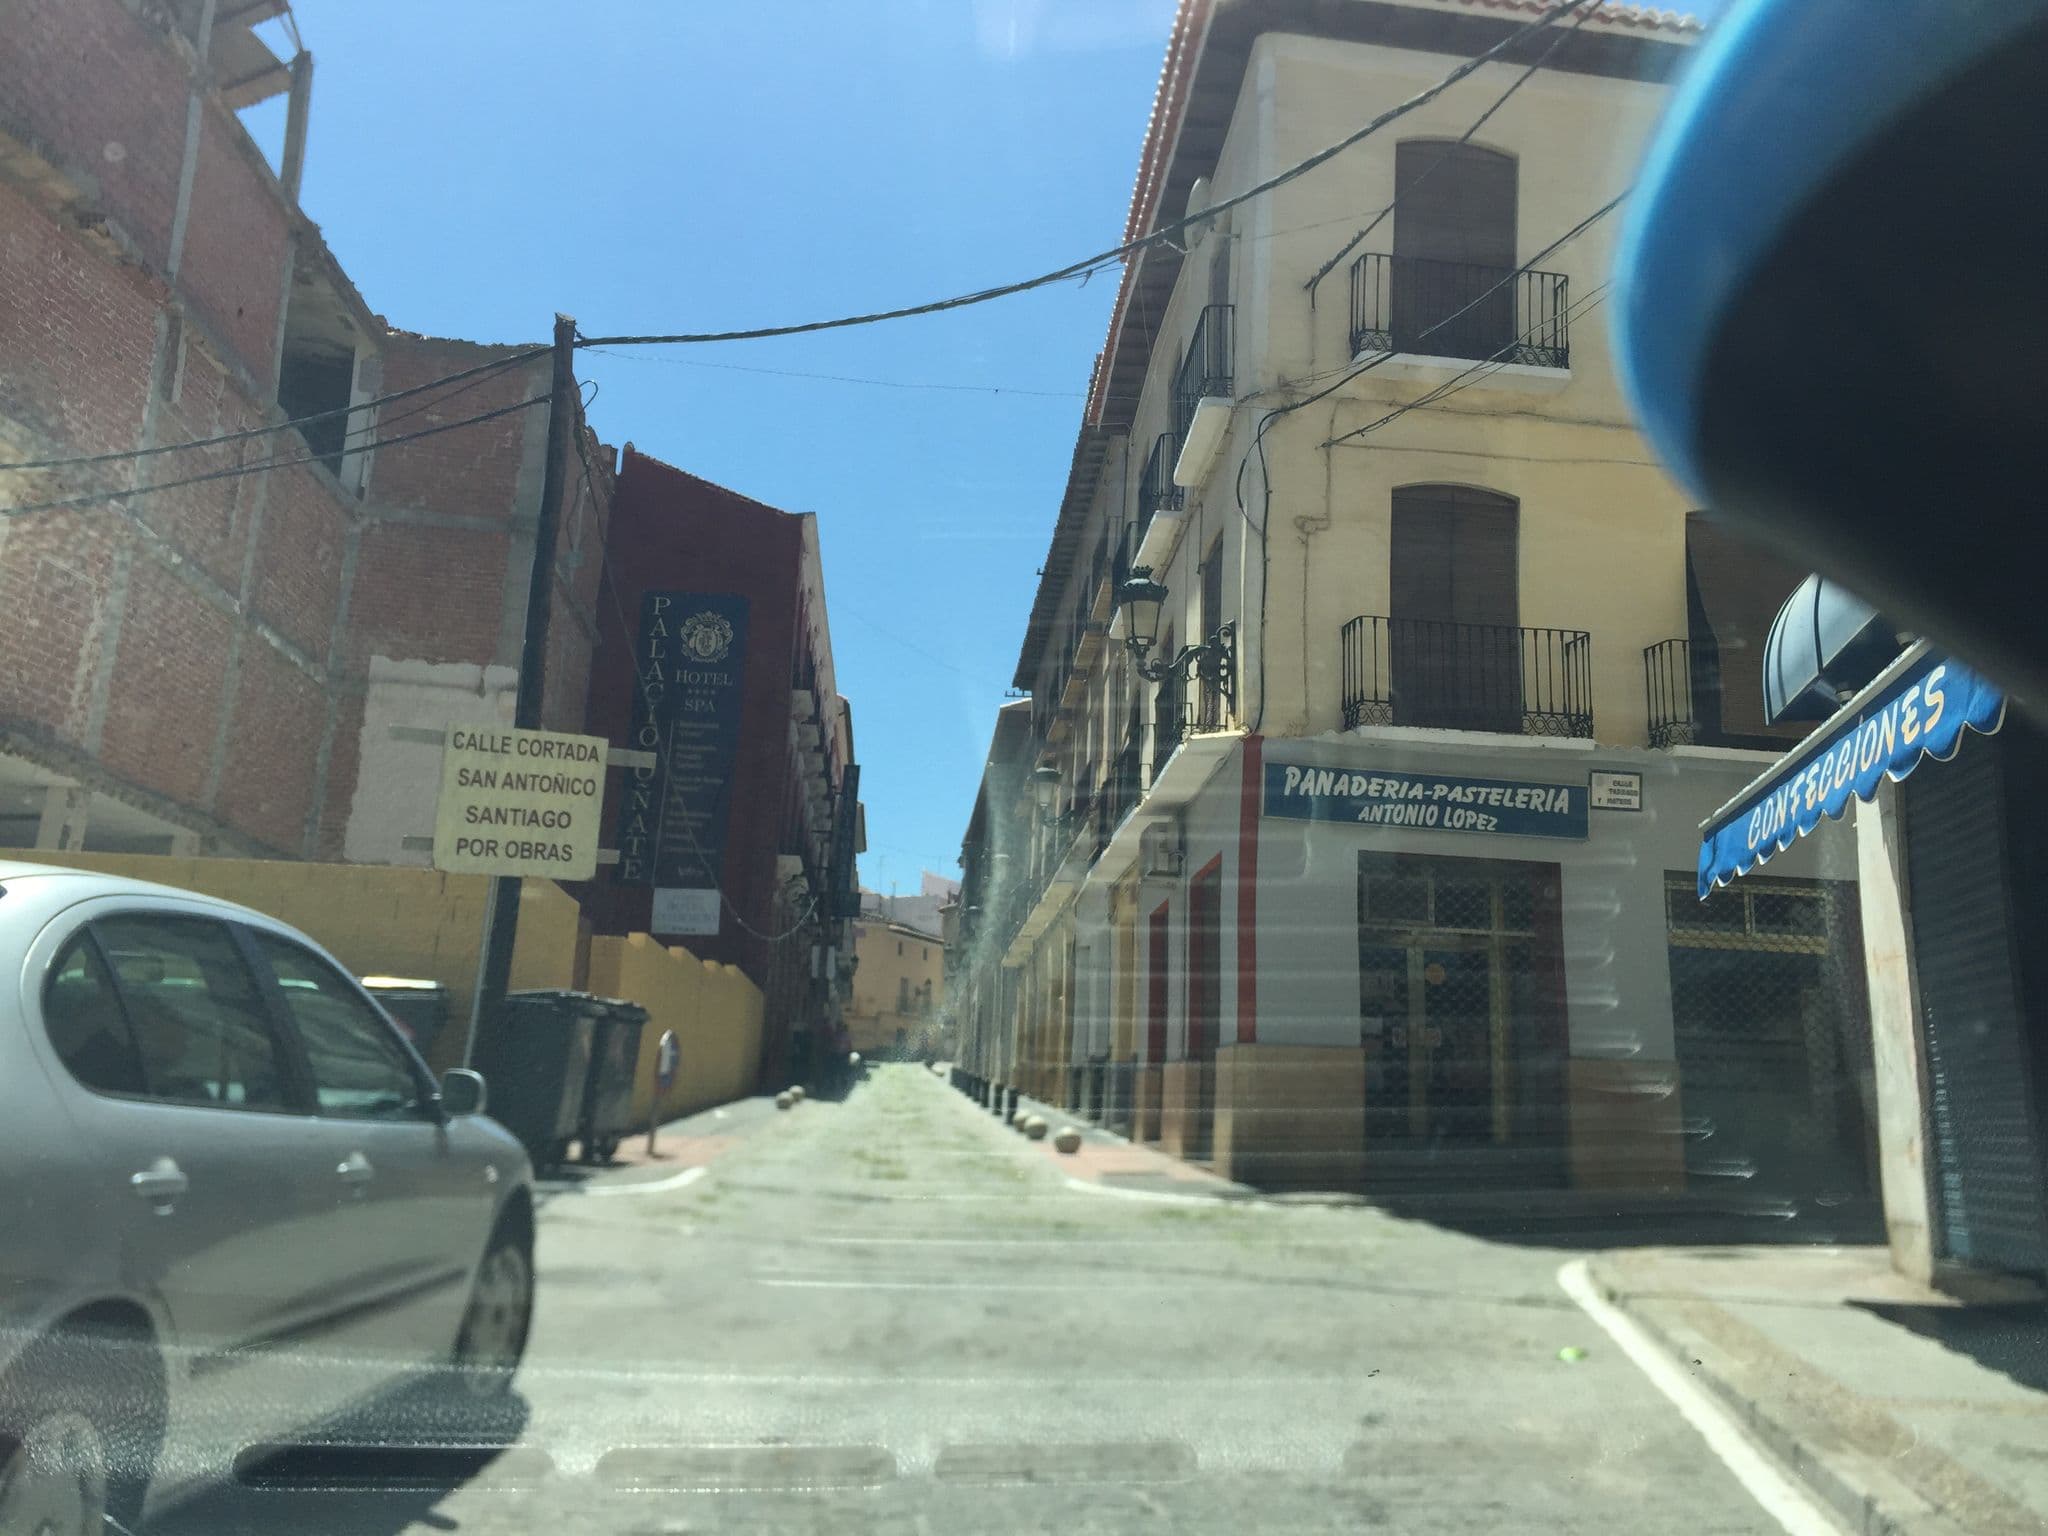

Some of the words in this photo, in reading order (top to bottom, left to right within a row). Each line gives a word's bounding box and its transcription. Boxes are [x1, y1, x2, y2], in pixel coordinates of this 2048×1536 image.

[640, 597, 671, 747] PALACIO
[675, 669, 734, 687] HOTEL
[685, 699, 716, 713] SPA
[453, 731, 512, 754] CALLE
[517, 738, 600, 763] CORTADA
[1747, 664, 1946, 851] CONFECCIONES
[458, 768, 497, 789] SAN
[501, 771, 597, 797] ANTOÑICO
[1284, 766, 1569, 815] PANADERIA-PASTELERIA
[465, 805, 572, 830] SANTIAGO
[1357, 803, 1439, 828] ANTONIO
[1443, 806, 1498, 832] LOPEZ
[456, 837, 499, 858] POR
[505, 840, 573, 863] OBRAS
